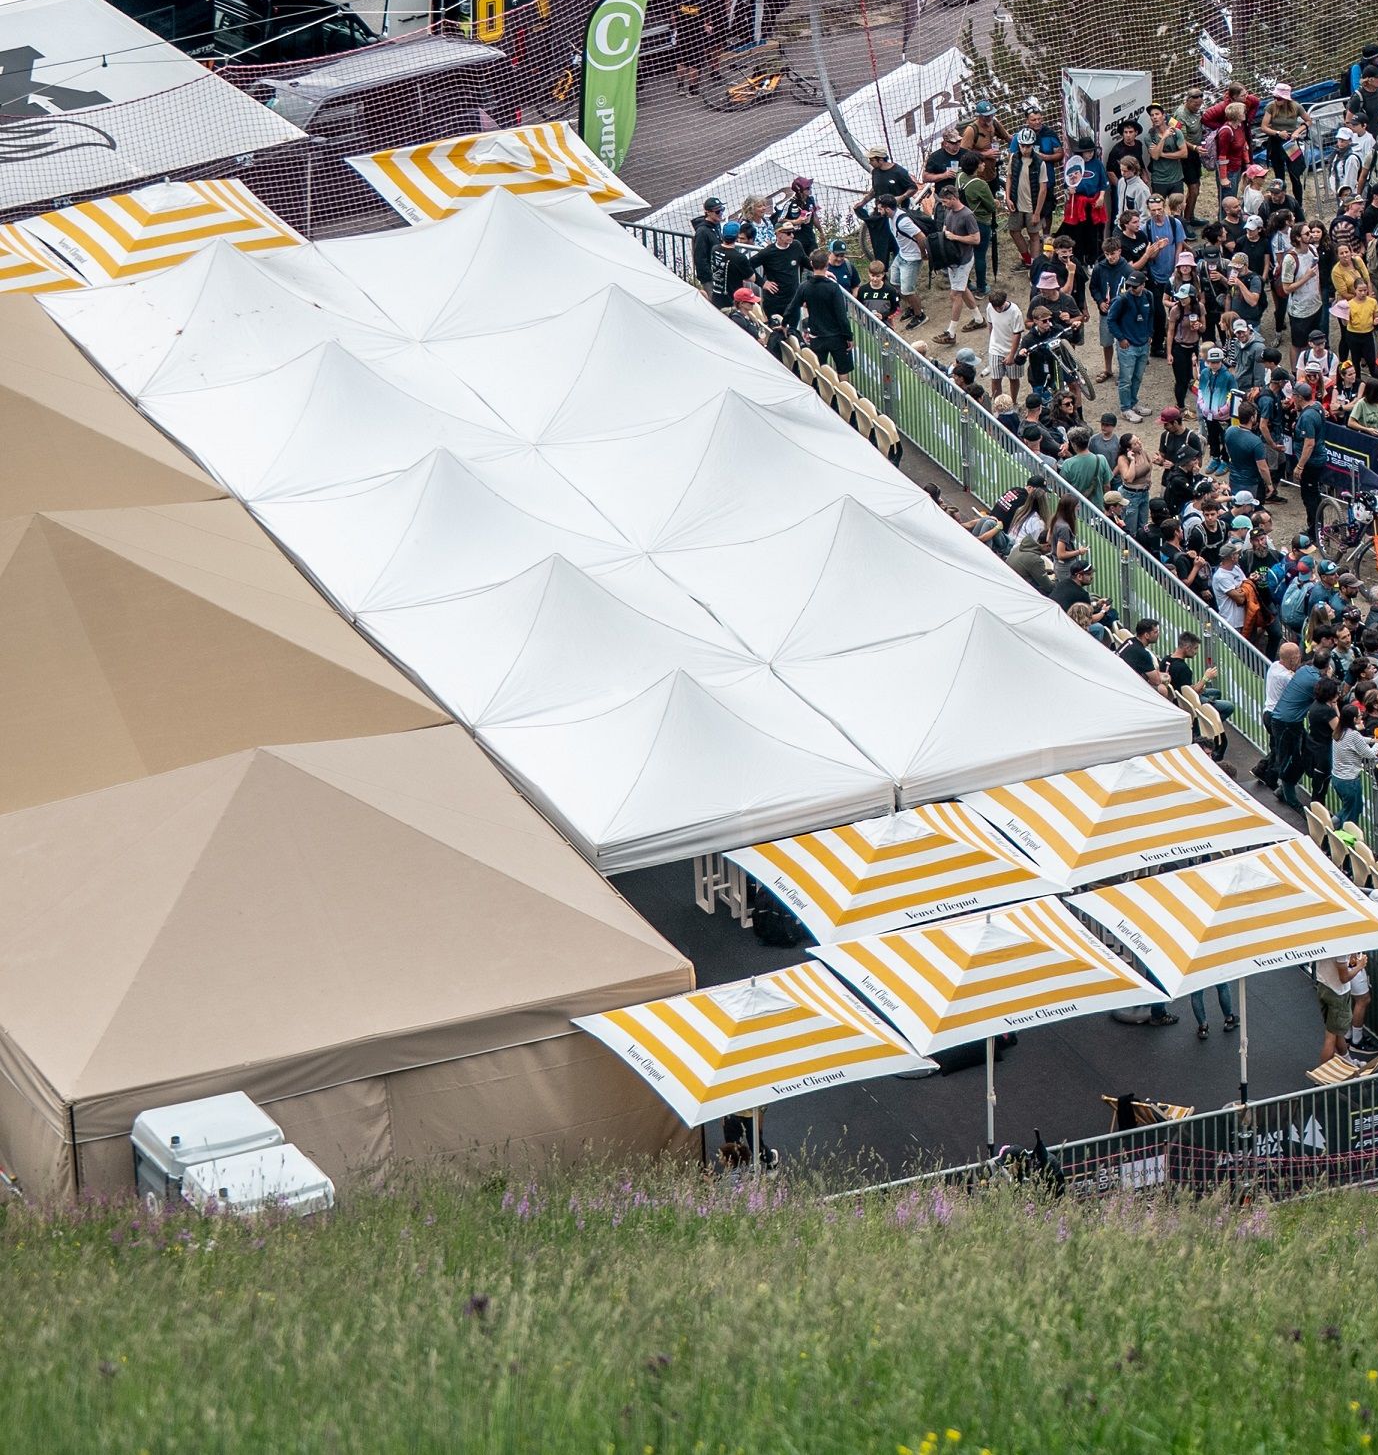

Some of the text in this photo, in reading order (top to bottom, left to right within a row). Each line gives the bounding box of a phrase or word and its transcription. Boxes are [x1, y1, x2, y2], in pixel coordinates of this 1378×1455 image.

[1139, 840, 1214, 862] Veuve Clicquot
[904, 895, 980, 920] Veuve Clicquot
[1253, 945, 1327, 967] Veuve Clicquot
[1004, 1003, 1080, 1027] Veuve Clicquot
[771, 1070, 847, 1095] Veuve Clicquot
